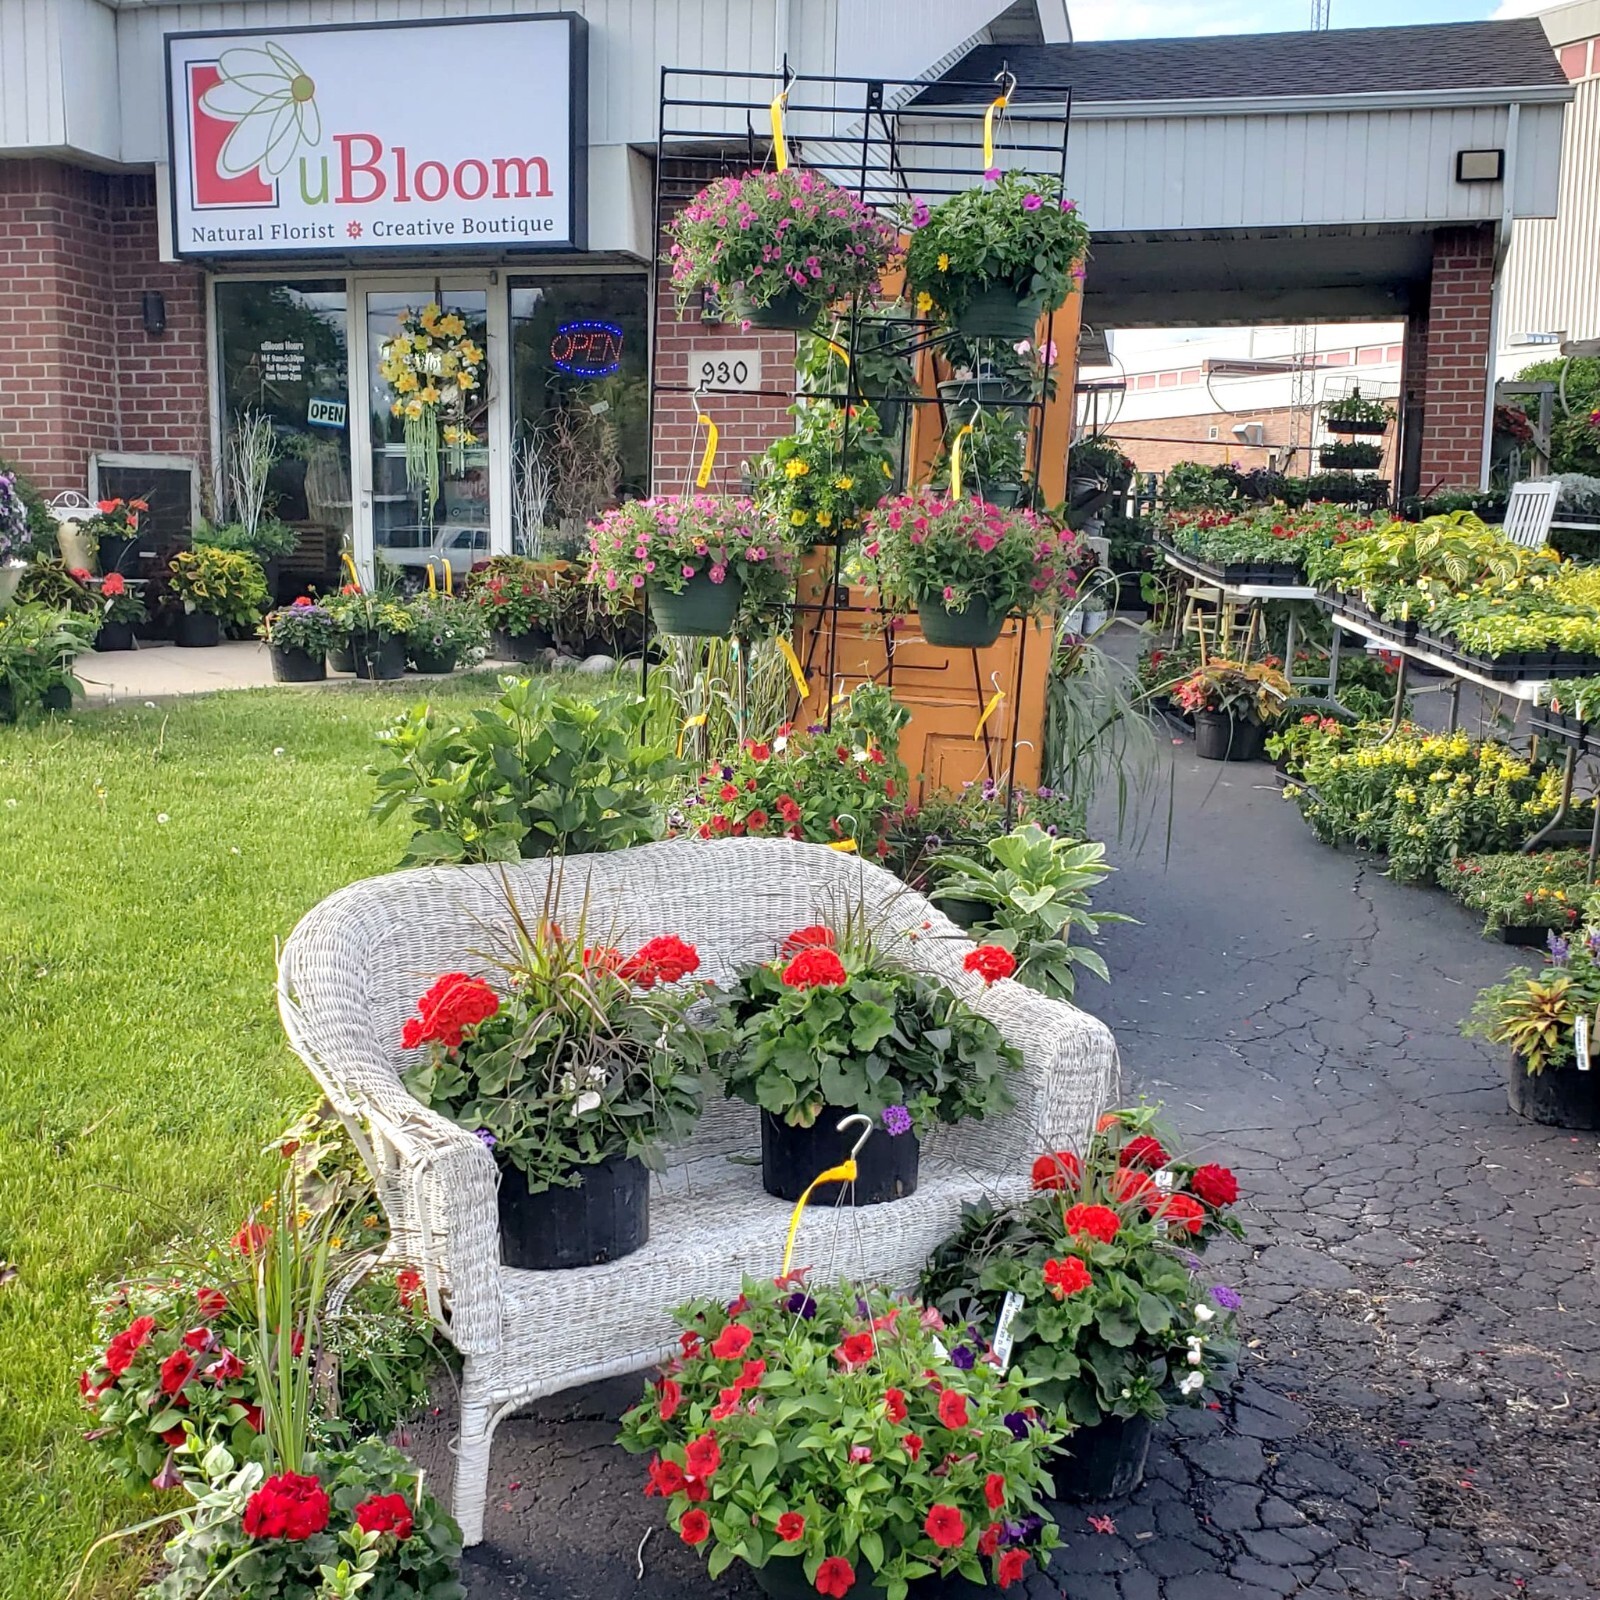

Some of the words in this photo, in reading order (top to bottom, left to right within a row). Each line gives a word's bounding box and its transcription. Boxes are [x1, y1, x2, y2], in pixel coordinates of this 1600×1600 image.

[300, 133, 554, 205] uBloom
[192, 224, 263, 242] Natural
[271, 222, 335, 240] Florist
[372, 218, 455, 236] Creative
[462, 215, 554, 236] Boutique
[550, 333, 624, 362] OPEN
[702, 360, 748, 384] 930
[310, 403, 344, 423] OPEN
